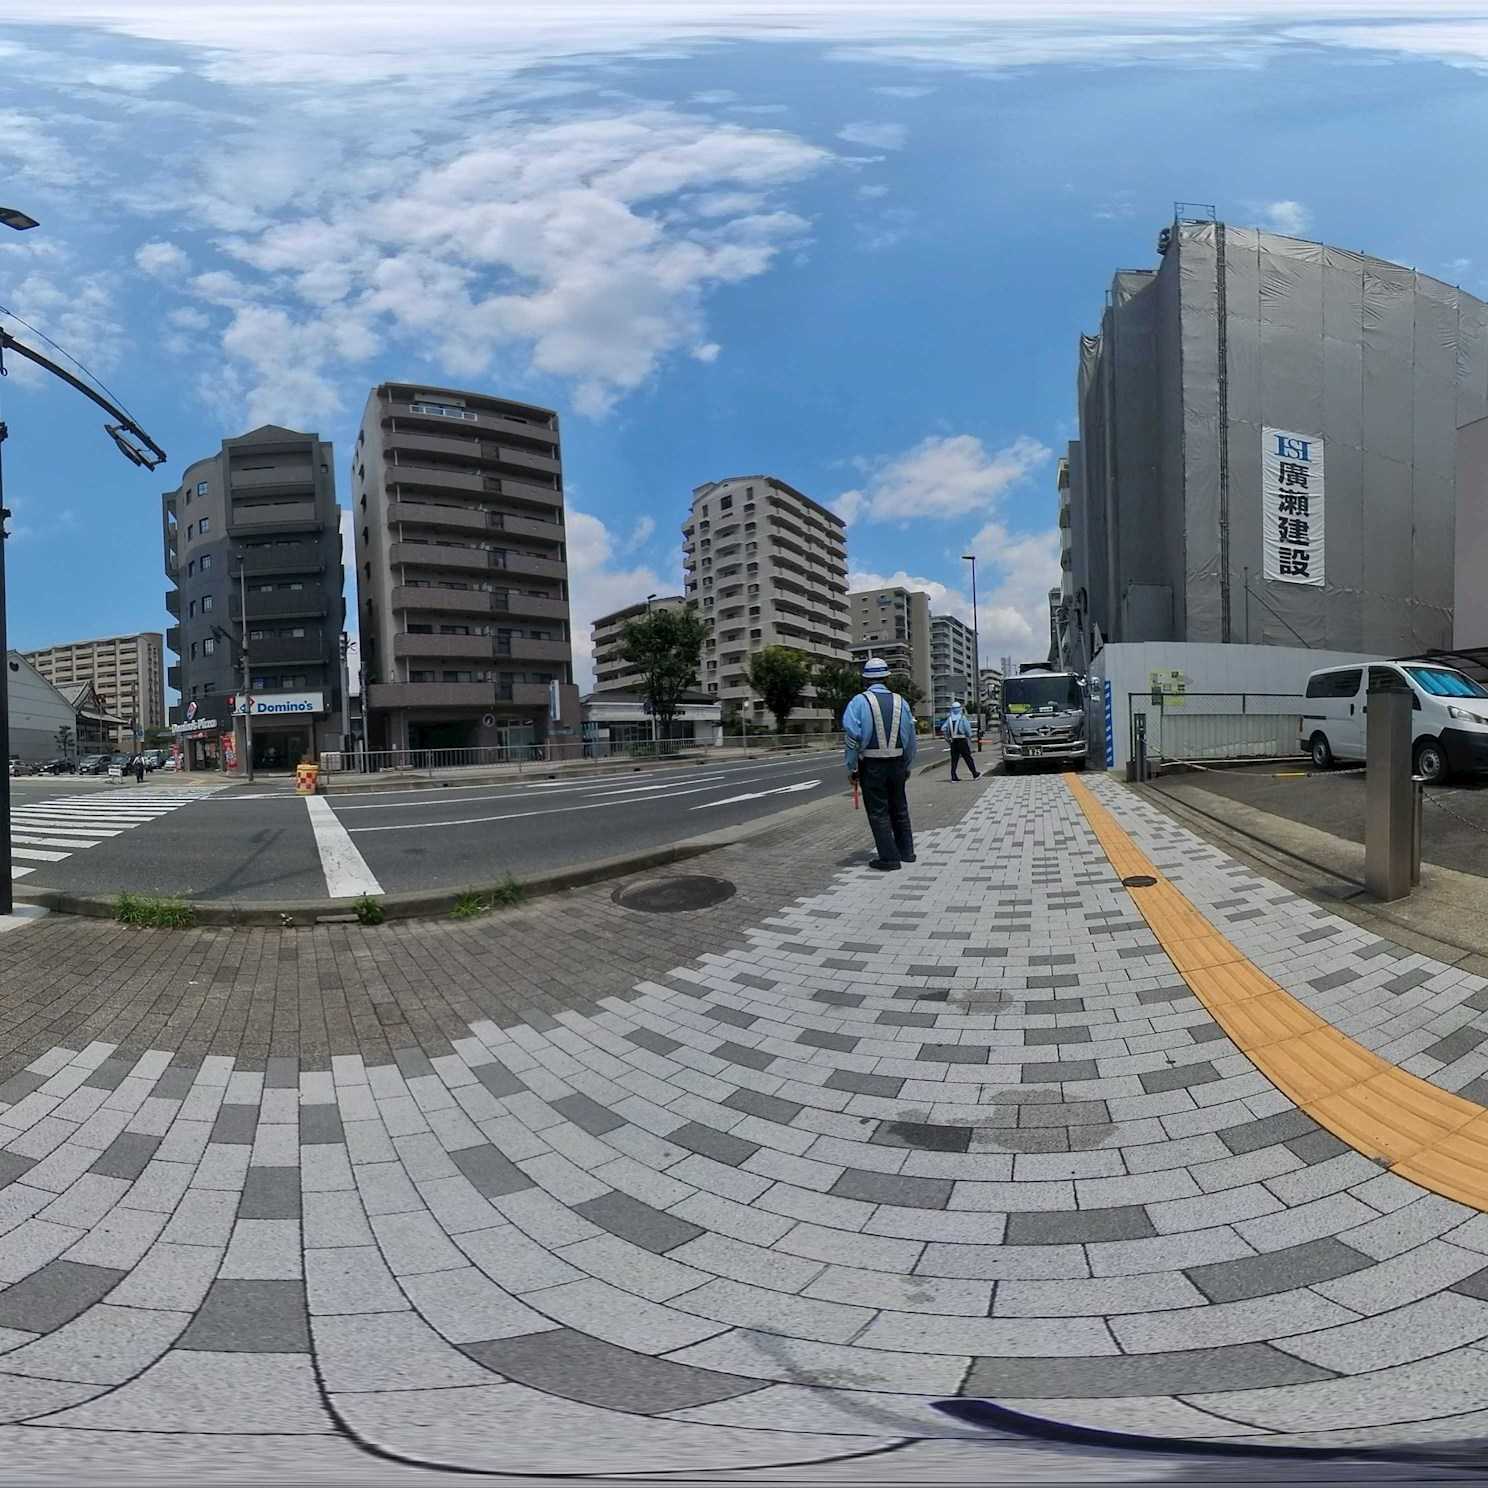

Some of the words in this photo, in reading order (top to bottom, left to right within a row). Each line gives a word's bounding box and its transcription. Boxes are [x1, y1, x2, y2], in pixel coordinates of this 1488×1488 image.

[1278, 462, 1310, 577] 廣瀬建設
[257, 700, 313, 713] Domino's
